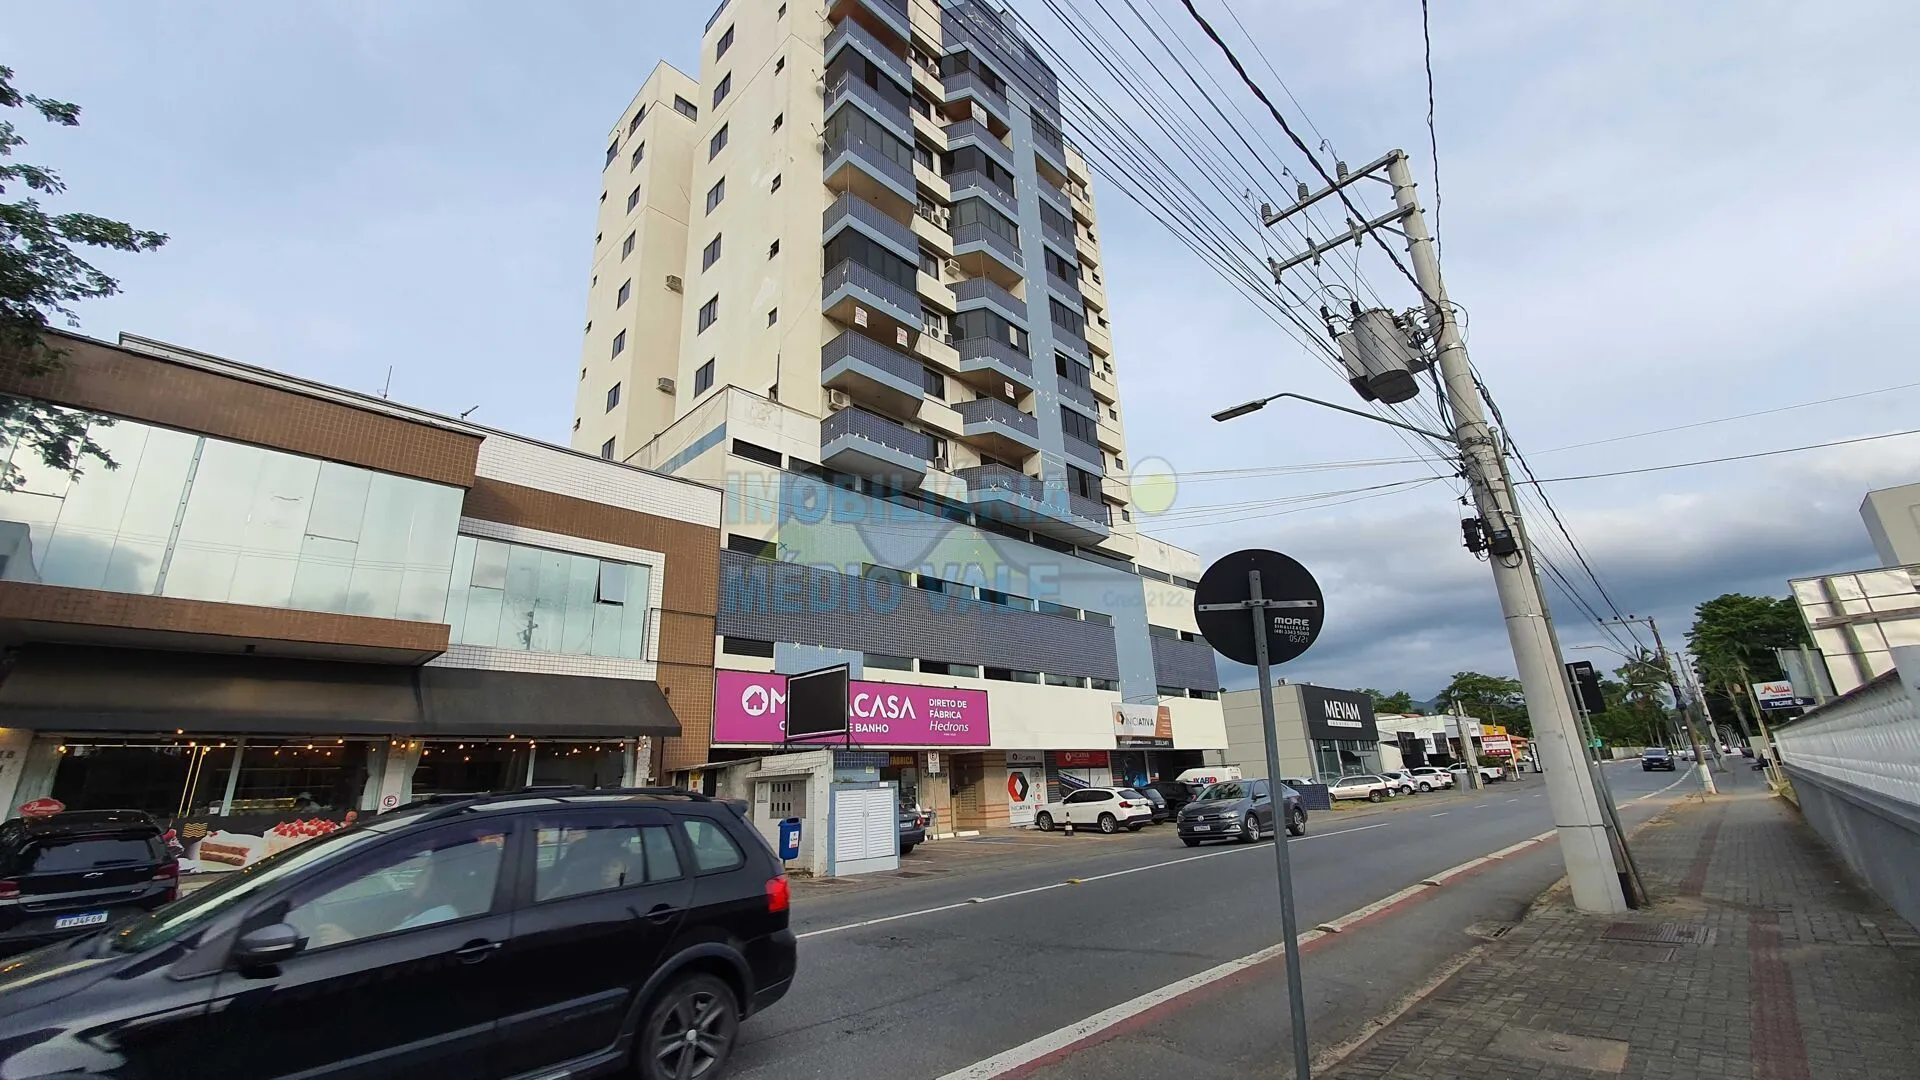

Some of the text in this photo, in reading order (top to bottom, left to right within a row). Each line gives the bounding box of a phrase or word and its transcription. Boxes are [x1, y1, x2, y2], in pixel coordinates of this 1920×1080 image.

[1274, 617, 1310, 626] MORE
[928, 699, 968, 709] DIRETO DE
[1769, 699, 1793, 707] TIGRE
[929, 708, 962, 719] FÁBRICA
[1324, 699, 1361, 721] MEVAM
[855, 723, 889, 733] BANHO
[929, 720, 969, 732] Hedrons
